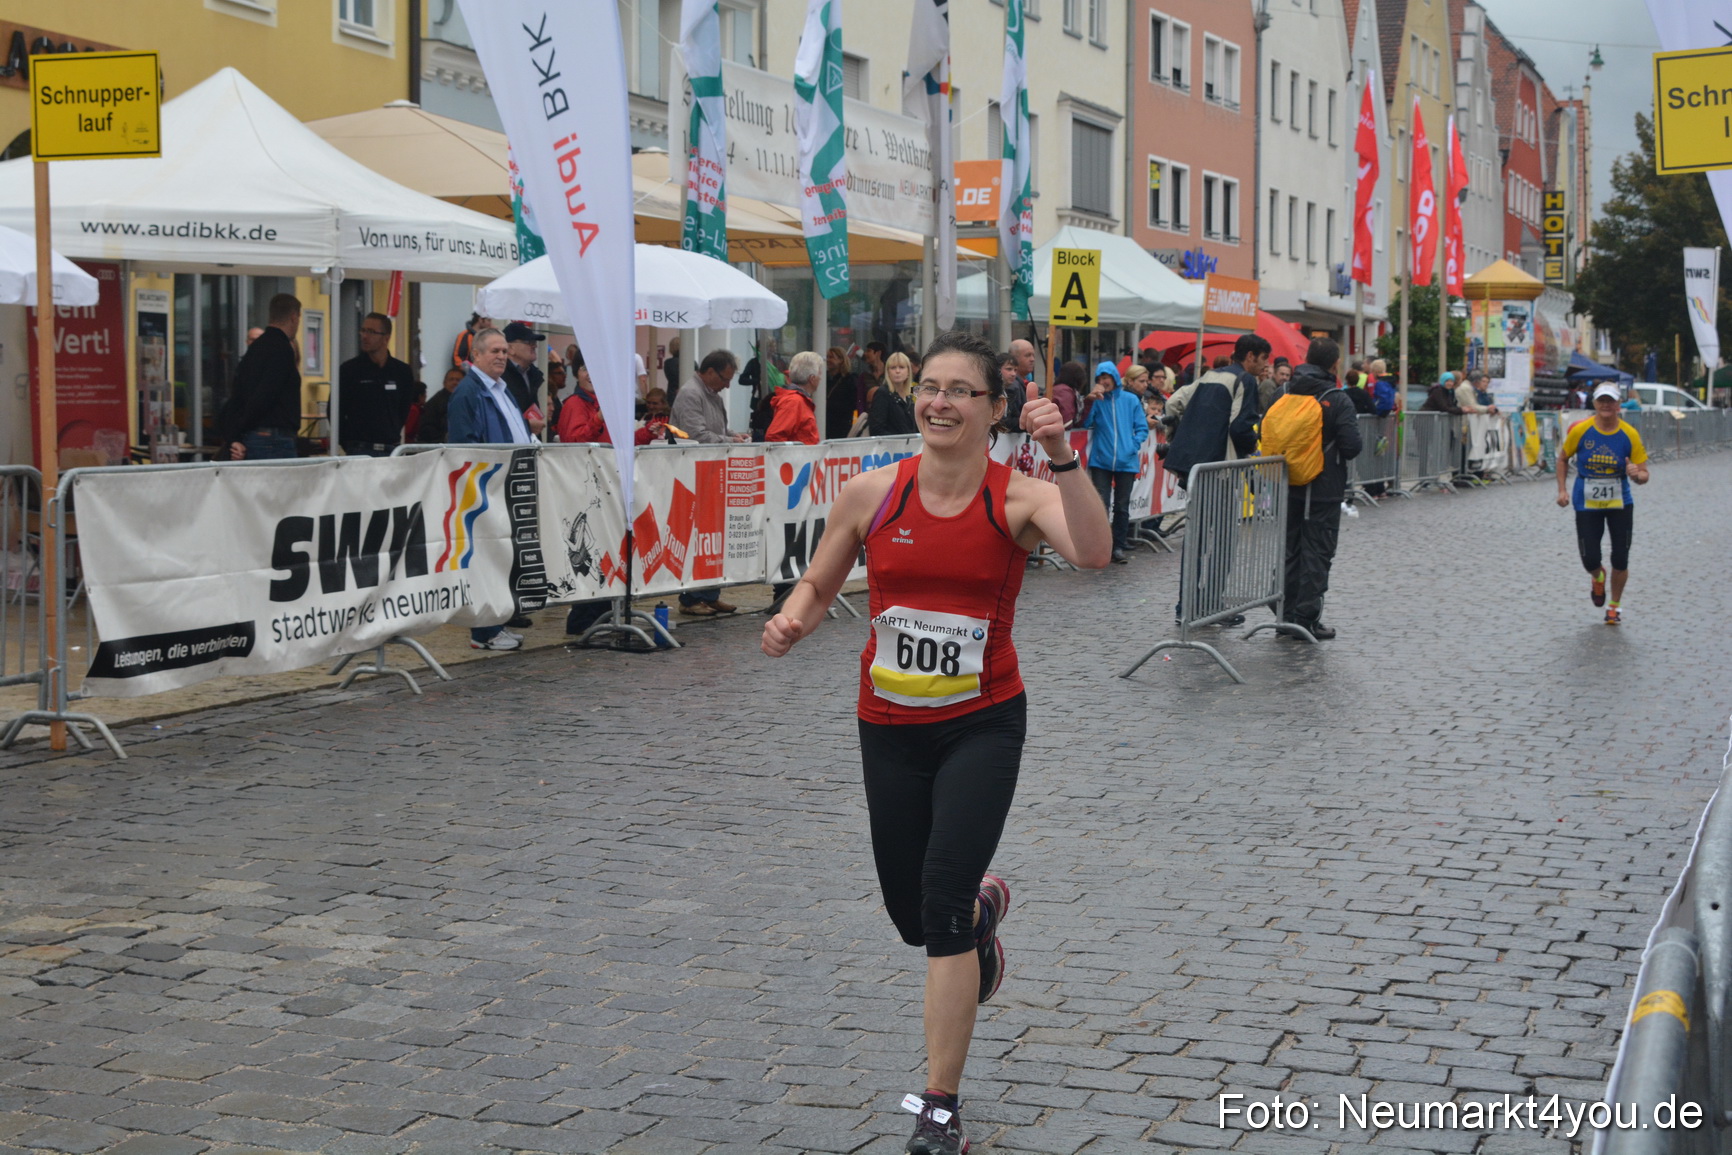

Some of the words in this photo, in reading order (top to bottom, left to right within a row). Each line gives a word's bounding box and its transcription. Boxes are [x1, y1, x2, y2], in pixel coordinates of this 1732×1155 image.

[41, 85, 150, 107] Schnupper-
[78, 112, 114, 133] lauf
[81, 220, 278, 242] www.audibkk.de
[359, 226, 388, 248] Von
[393, 234, 422, 253] uns,
[425, 231, 445, 251] für
[448, 239, 476, 255] uns:
[479, 239, 508, 260] Audi
[1057, 251, 1095, 266] Block
[1060, 271, 1088, 309] A
[652, 310, 689, 324] BKK
[1592, 486, 1615, 500] 241
[664, 523, 686, 563] Braun
[694, 527, 723, 557] Braun
[891, 536, 914, 545] erima
[382, 578, 474, 621] neumarkt
[874, 614, 911, 630] PARTL
[914, 620, 968, 638] Neumarkt
[114, 649, 164, 669] Leistungen,
[167, 643, 188, 660] die
[191, 635, 248, 656] verbinden
[896, 632, 962, 678] 608
